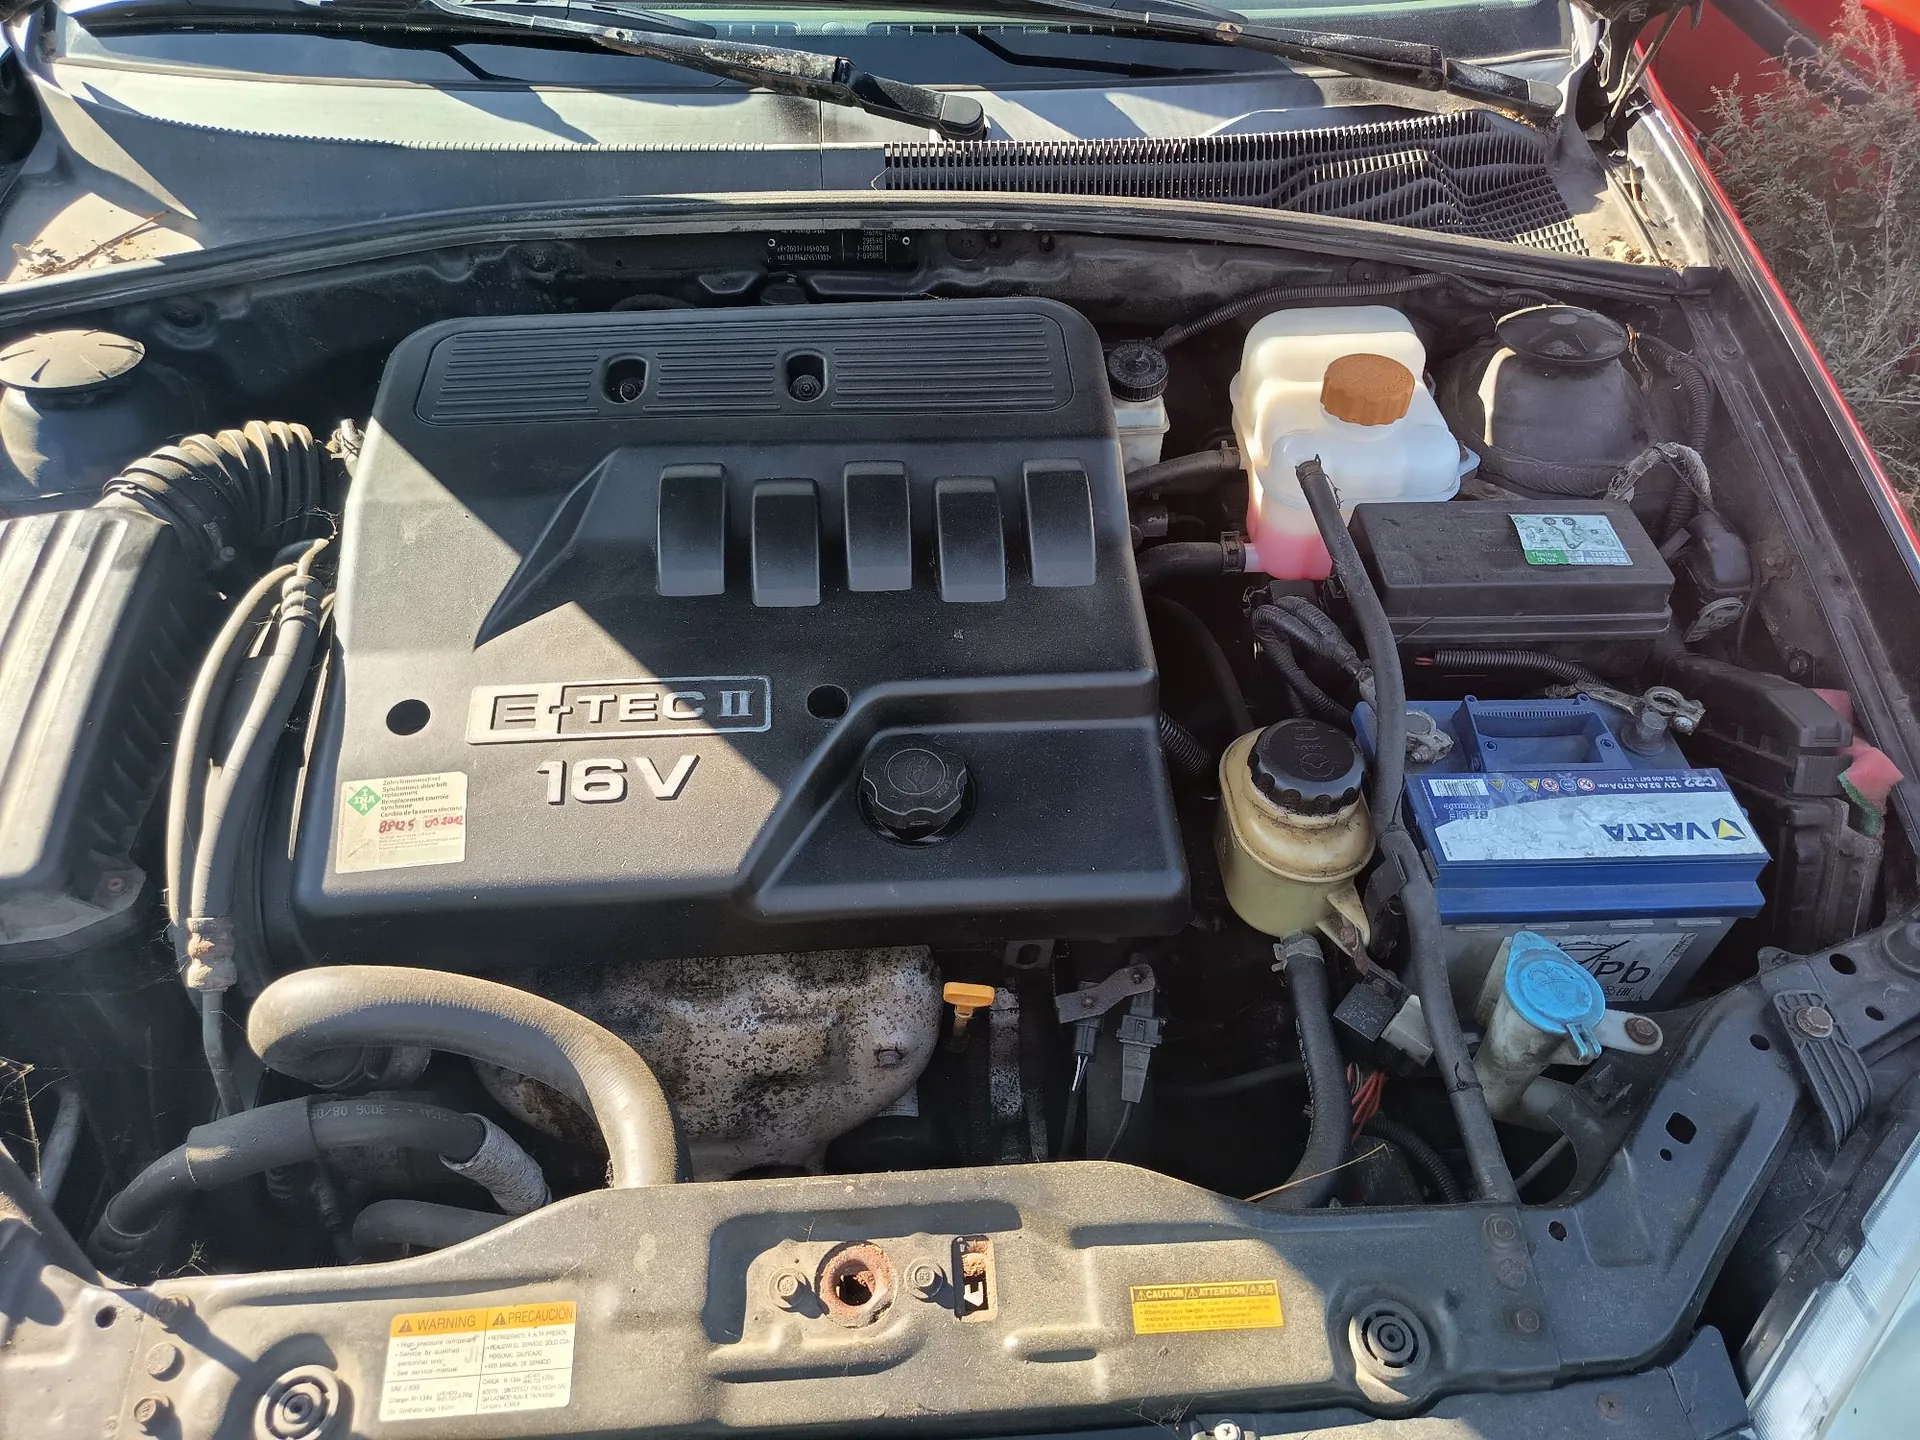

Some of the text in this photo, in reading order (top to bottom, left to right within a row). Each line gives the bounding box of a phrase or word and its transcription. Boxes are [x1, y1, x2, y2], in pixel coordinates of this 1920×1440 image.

[537, 754, 700, 804] 16V
[1682, 776, 1717, 788] C22
[382, 785, 420, 793] Synchronous
[381, 797, 425, 805] Remplacement
[1599, 822, 1712, 842] VARTA
[1593, 960, 1651, 983] Pb
[1145, 1286, 1246, 1299] CAUTION ATTENTION
[417, 1306, 573, 1332] WARNING PRECAUCIÓN
